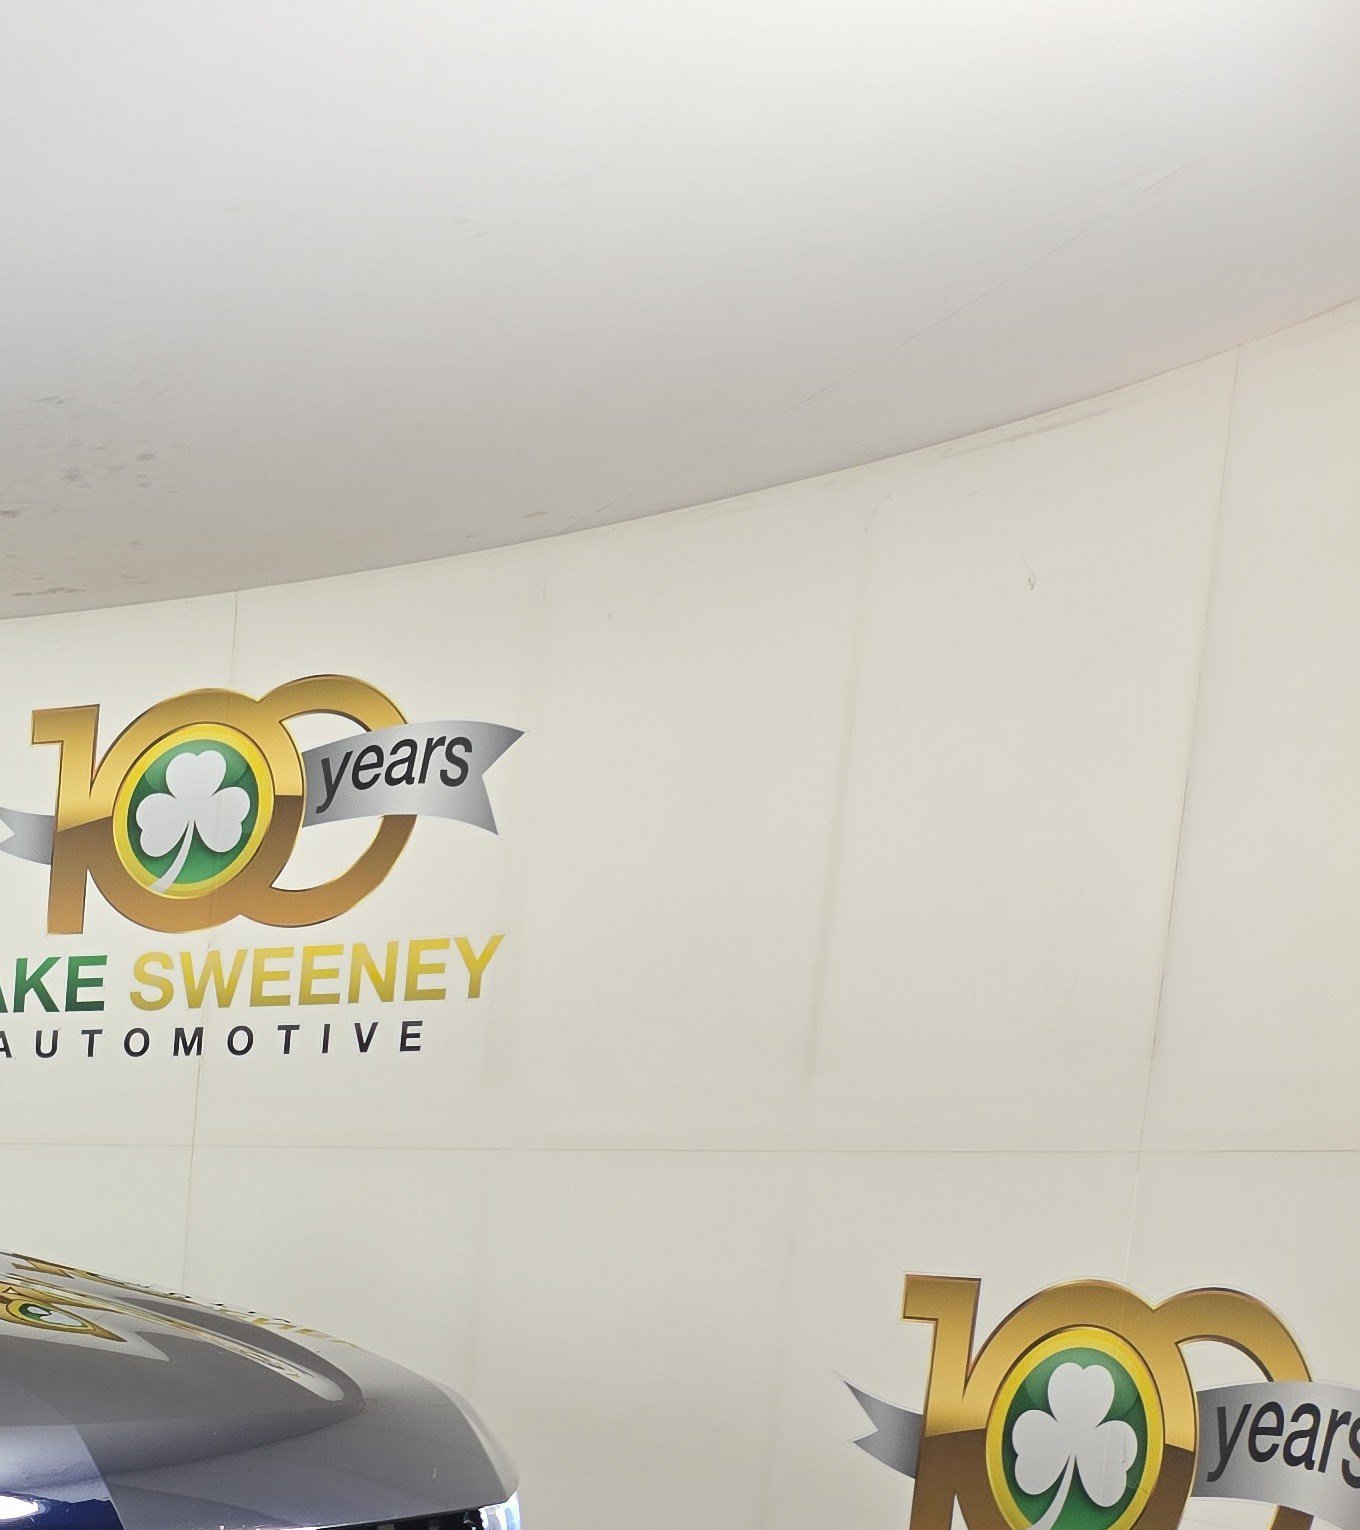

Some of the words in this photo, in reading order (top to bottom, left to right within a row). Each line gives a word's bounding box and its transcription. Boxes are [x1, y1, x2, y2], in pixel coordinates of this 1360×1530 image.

[31, 674, 420, 934] 100
[316, 735, 473, 814] years
[129, 933, 505, 1012] SWEENEY
[1206, 1401, 1360, 1489] years
